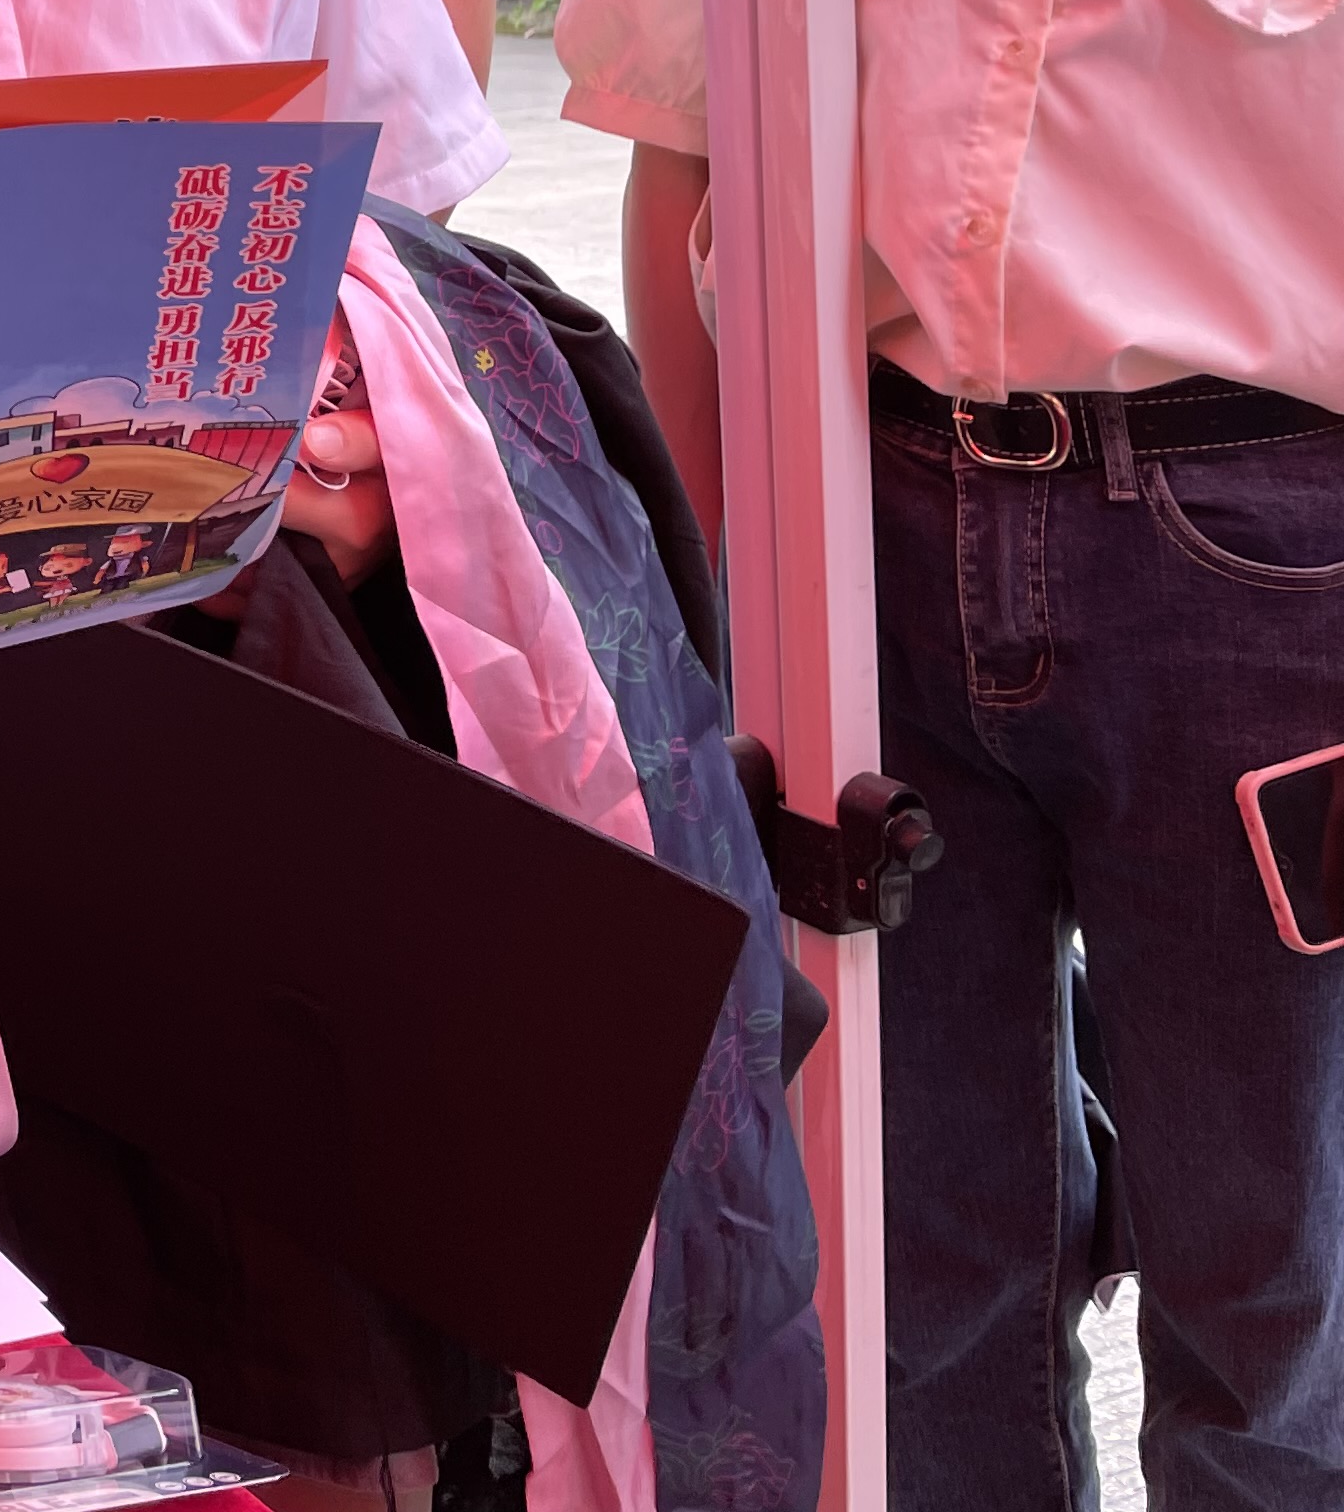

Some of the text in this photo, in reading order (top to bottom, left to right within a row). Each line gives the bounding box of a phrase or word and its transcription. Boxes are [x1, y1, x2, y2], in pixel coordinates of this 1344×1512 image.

[143, 163, 231, 402] 砥砺奋进 勇担当
[214, 163, 314, 399] 不忘初心 反邪行
